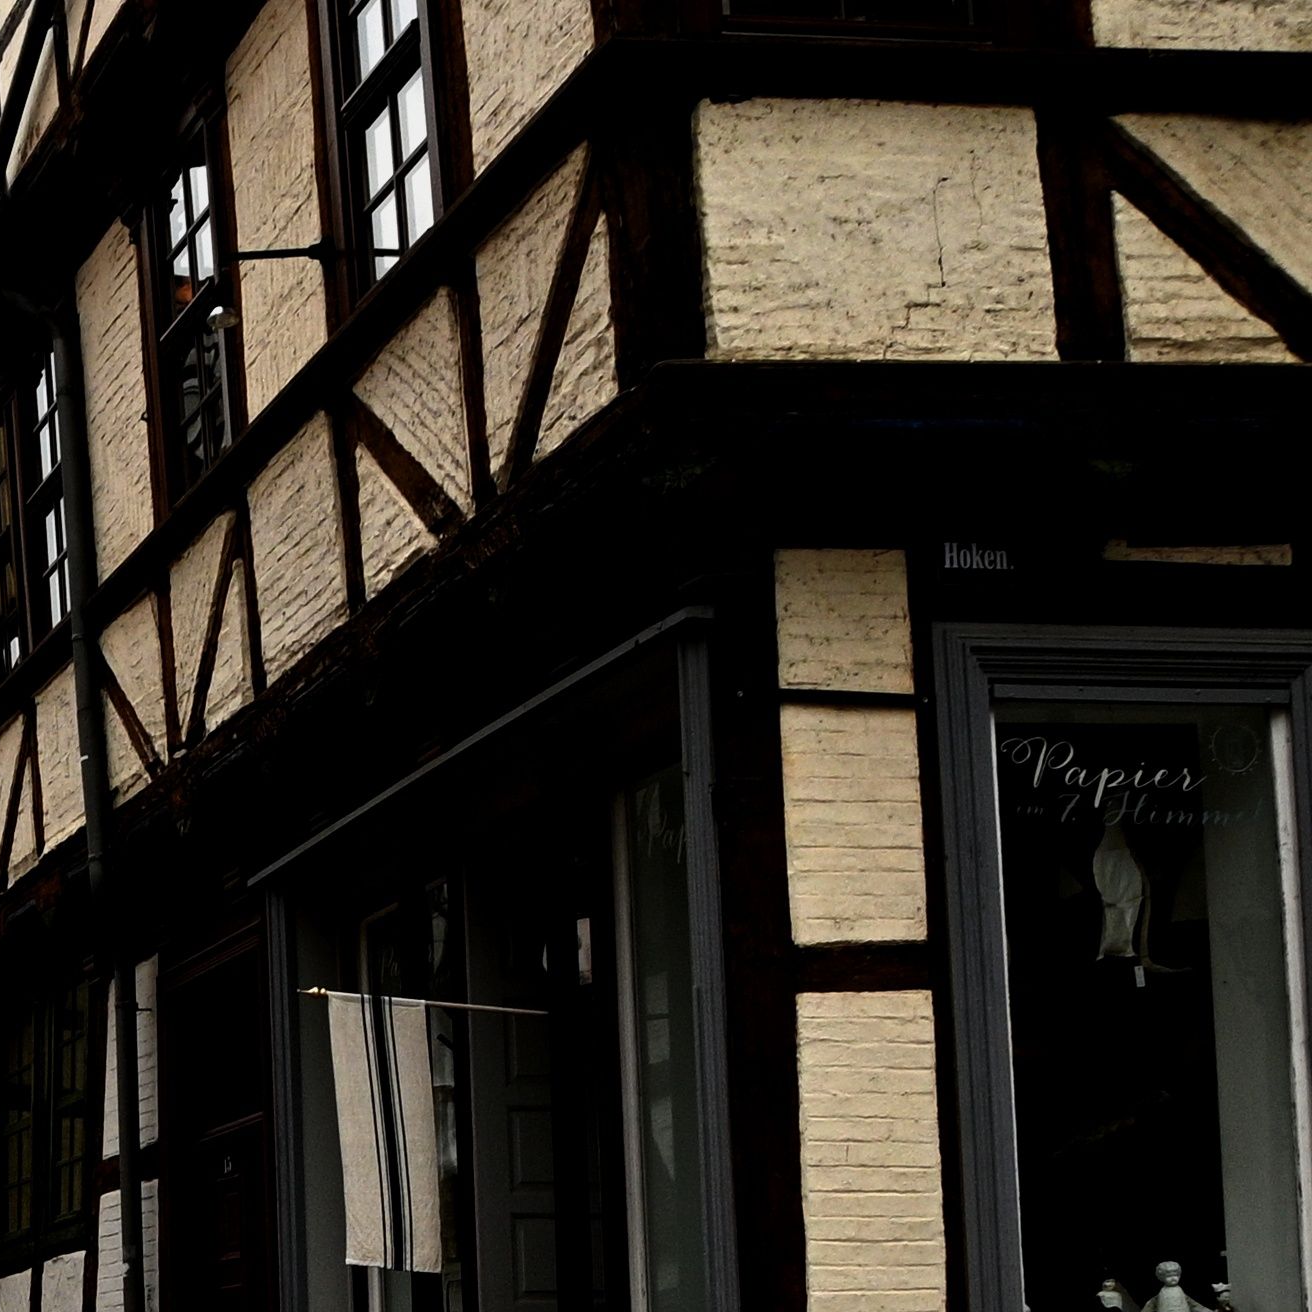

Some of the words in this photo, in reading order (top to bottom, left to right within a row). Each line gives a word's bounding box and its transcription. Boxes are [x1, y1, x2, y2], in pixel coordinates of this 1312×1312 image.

[943, 542, 1015, 570] Hoken.
[1000, 736, 1206, 808] Papier
[1056, 793, 1077, 823] 7.
